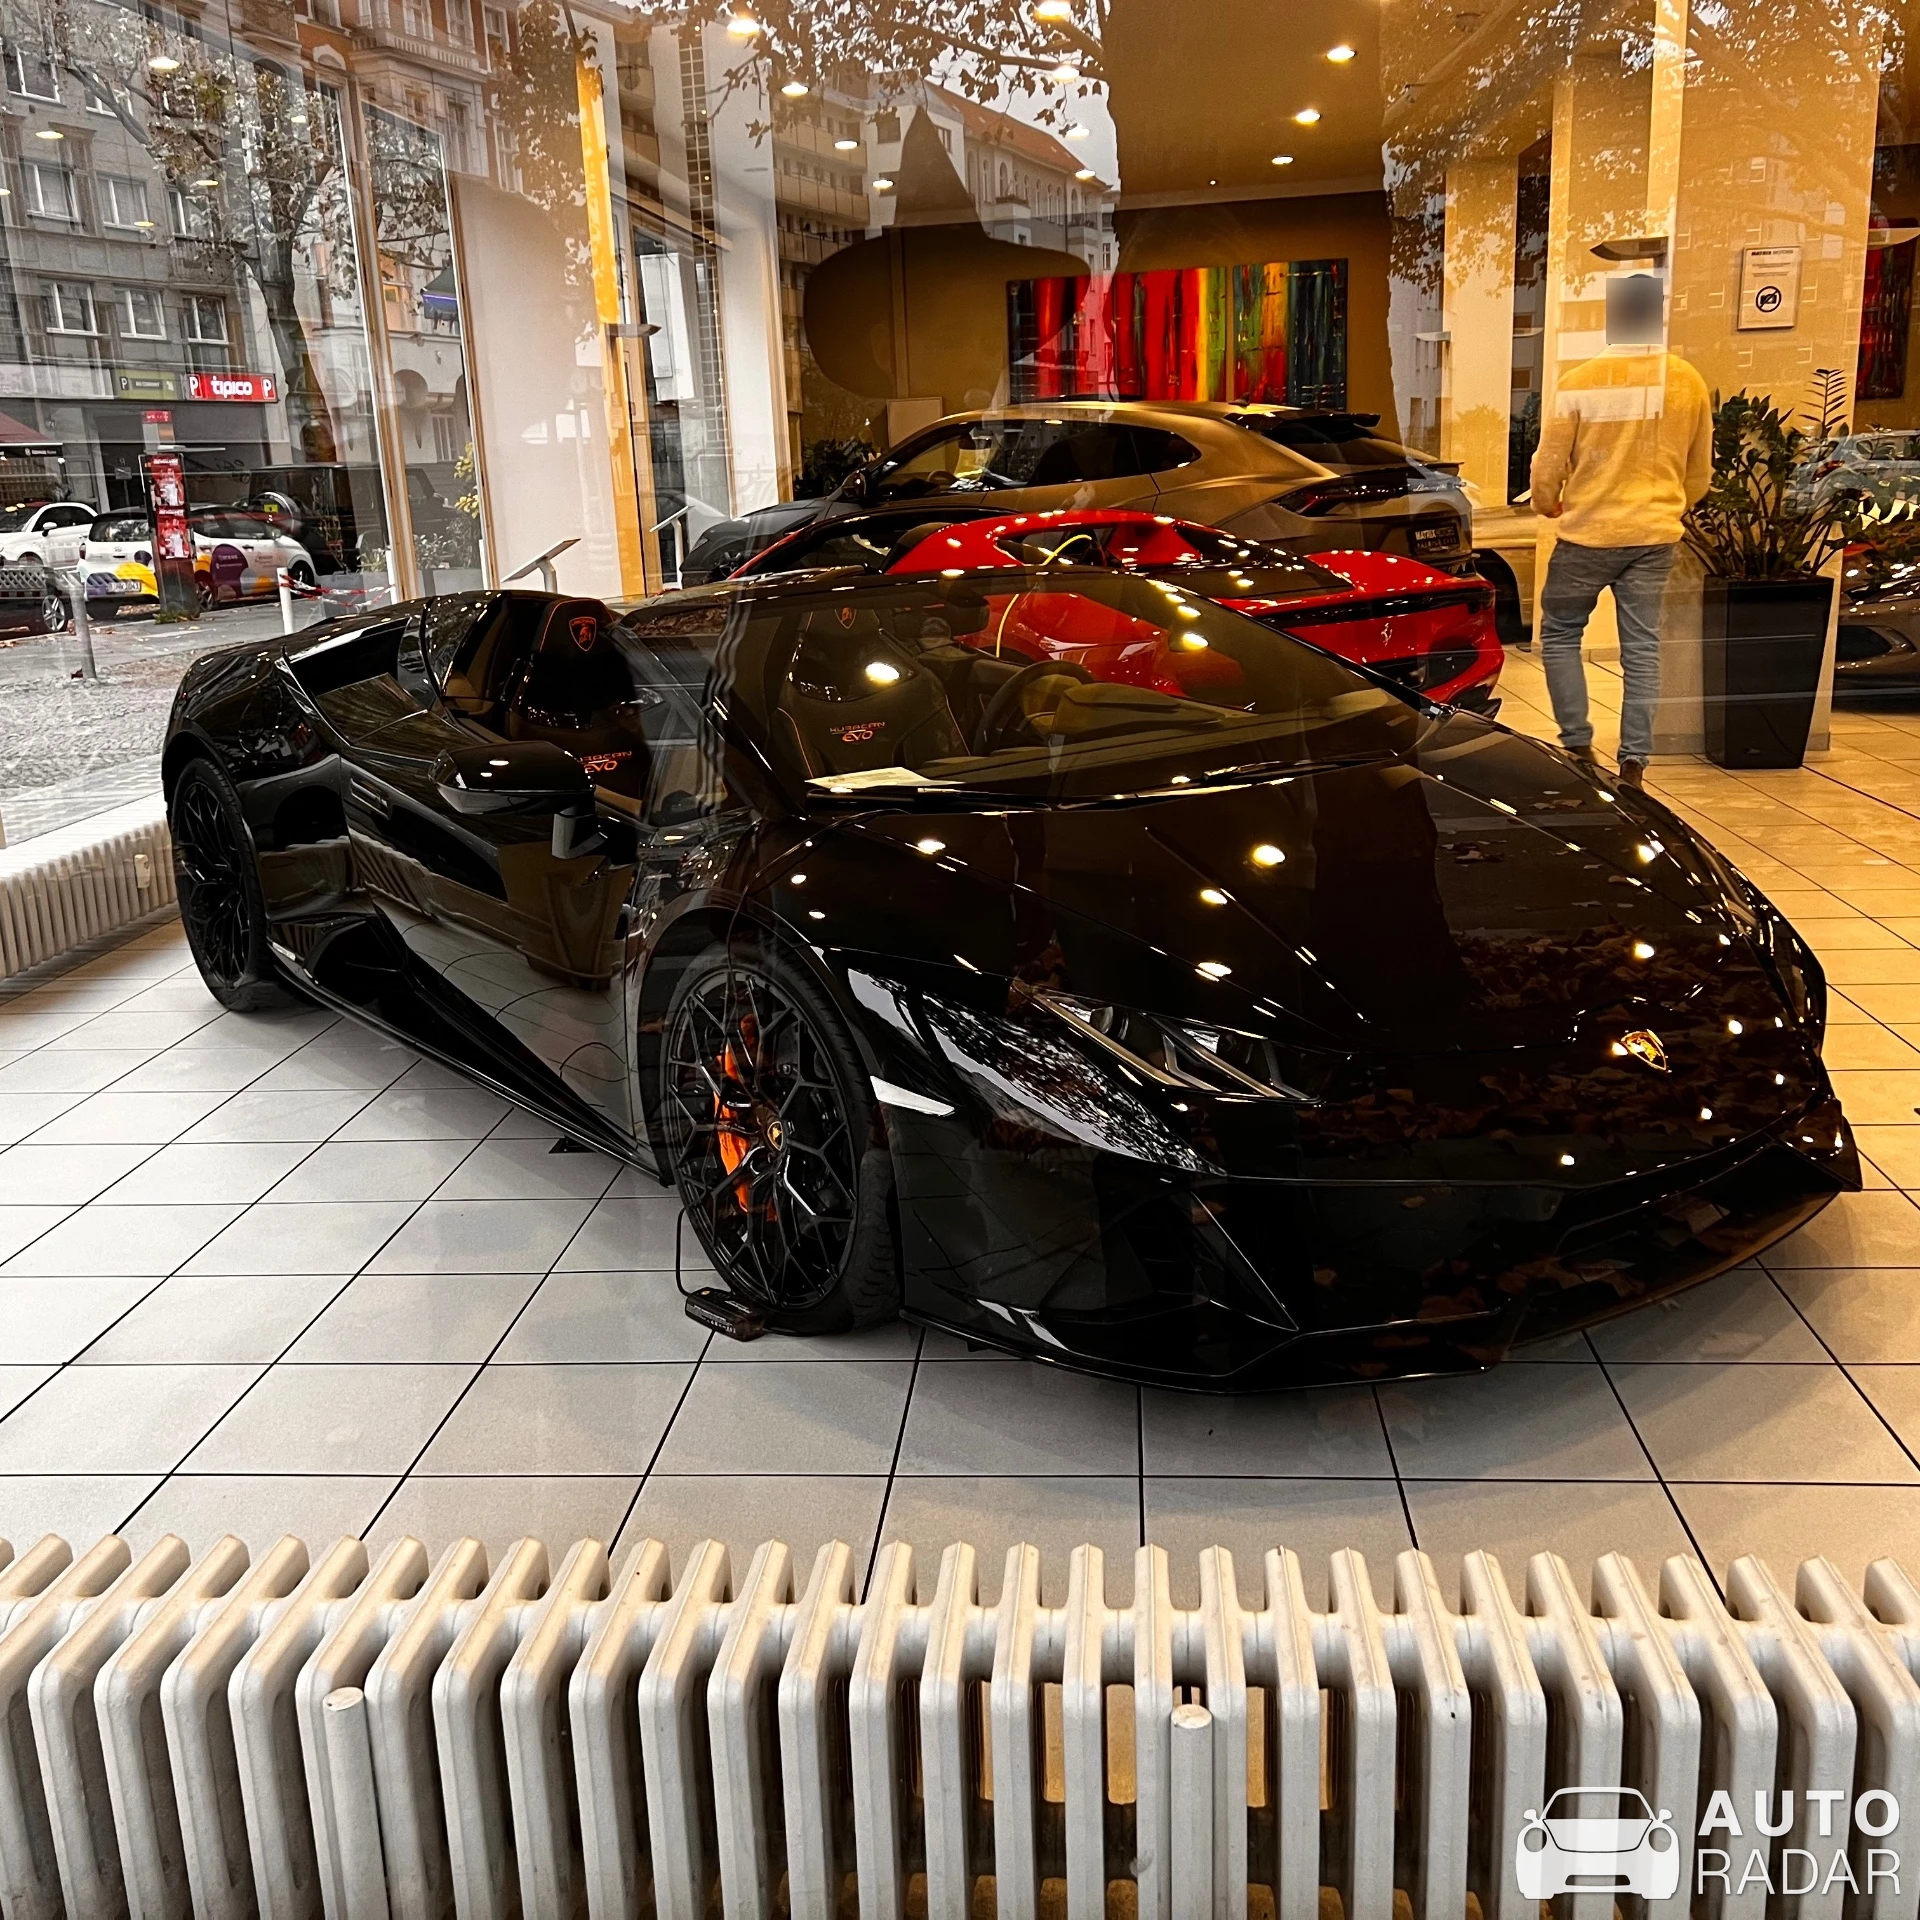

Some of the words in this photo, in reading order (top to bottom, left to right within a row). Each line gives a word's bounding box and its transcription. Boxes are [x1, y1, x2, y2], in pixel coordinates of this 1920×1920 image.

[189, 376, 199, 396] P
[210, 375, 253, 398] tipico
[262, 378, 272, 397] P
[1415, 529, 1437, 541] MATRIX
[842, 730, 874, 742] EVO
[583, 760, 618, 773] EVO
